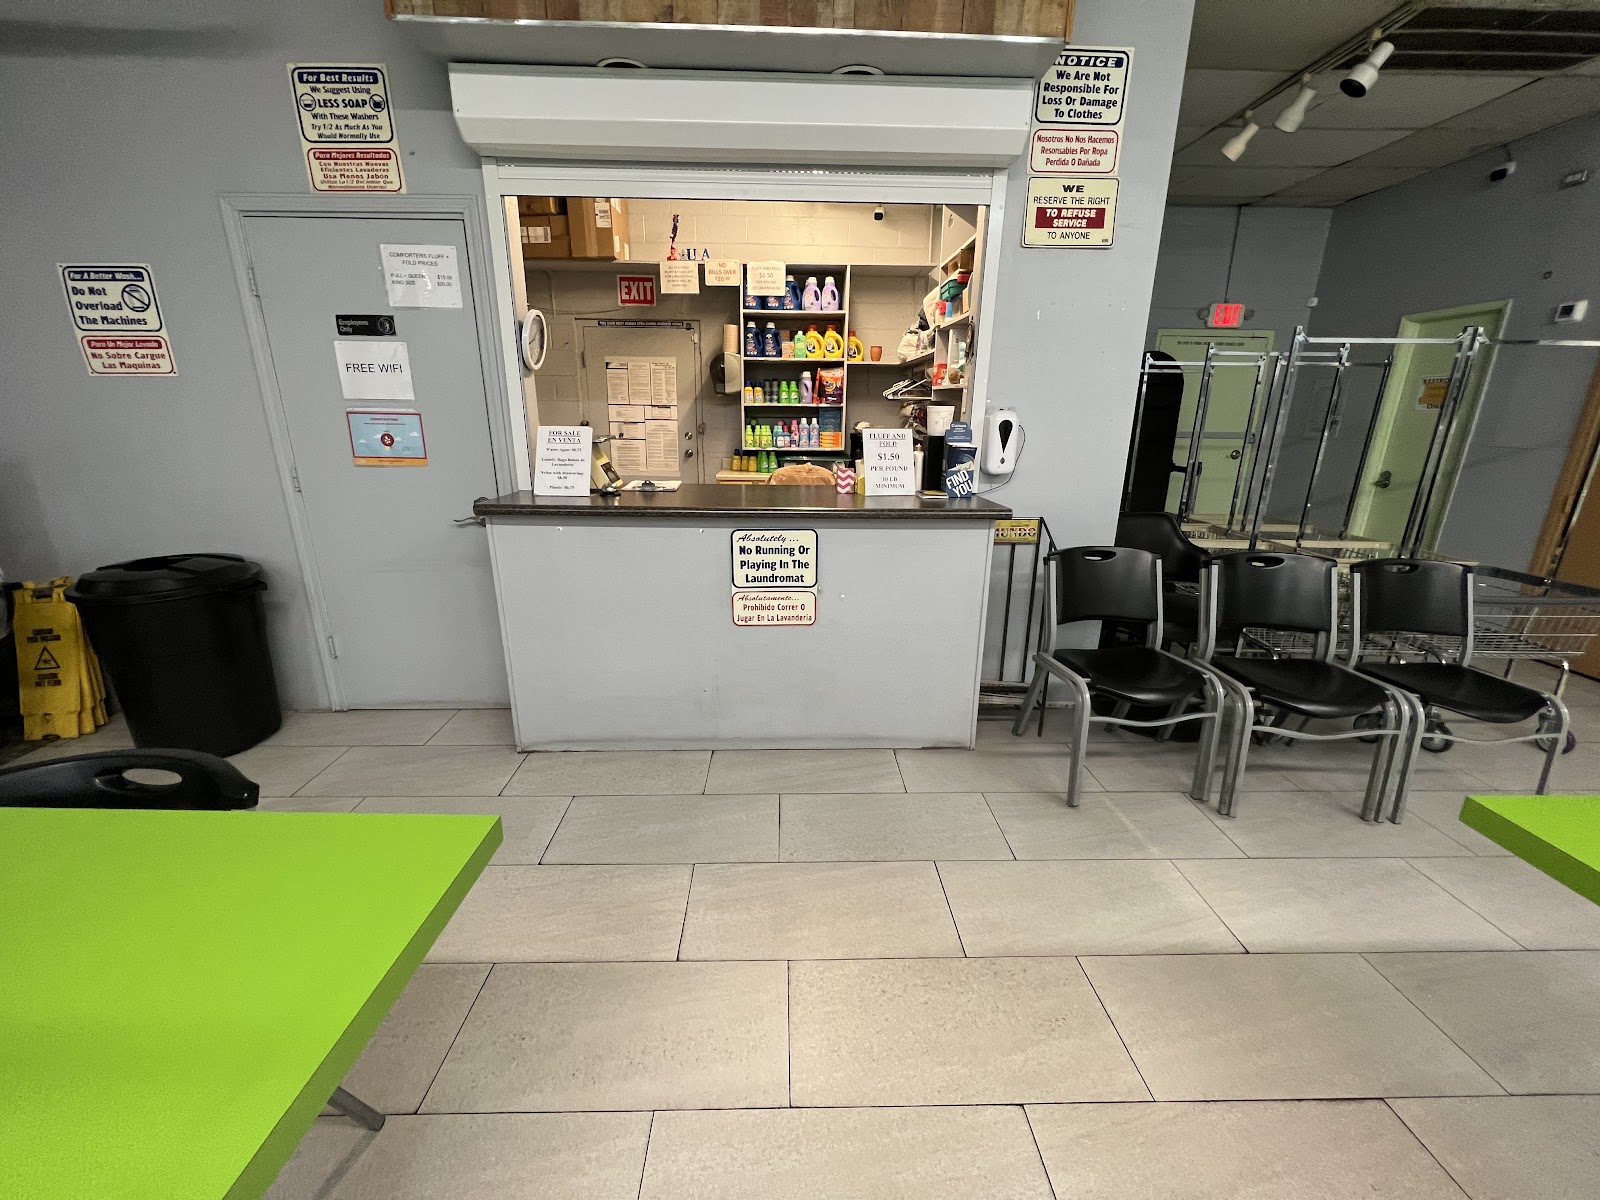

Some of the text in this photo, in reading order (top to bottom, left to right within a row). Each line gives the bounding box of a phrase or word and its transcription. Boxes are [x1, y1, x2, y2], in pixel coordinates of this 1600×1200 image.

[1055, 56, 1117, 67] NOTICE
[303, 74, 374, 82] For Best Results
[1056, 70, 1111, 81] We Are Not
[324, 86, 350, 94] Suggest
[1044, 83, 1119, 94] Responsible For
[318, 99, 367, 108] LESS SOAP
[1042, 96, 1117, 109] Loss Or Damage
[1054, 109, 1103, 119] To Clothes
[1037, 135, 1063, 143] Nosotros
[1065, 135, 1073, 143] No
[1075, 135, 1086, 143] Nos
[1080, 147, 1090, 155] Por
[1092, 148, 1107, 156] Ropa
[1046, 158, 1069, 166] Perdida
[1033, 196, 1067, 204] RESERVE
[1046, 209, 1096, 217] TO REFUSE
[1053, 219, 1087, 227] SERVICE
[71, 286, 107, 296] Do Not
[621, 281, 653, 300] EXIT
[76, 302, 123, 311] Overload
[1213, 304, 1242, 326] EXIT
[79, 316, 147, 325] The Machines
[135, 352, 165, 360] Cargue
[120, 362, 160, 370] Maquinas
[346, 363, 402, 373] FREE WIFI
[946, 470, 969, 489] FIND
[952, 480, 972, 497] YOU
[995, 528, 1036, 537] UNDO
[737, 534, 786, 543] Absolutely
[739, 545, 810, 556] No Running Or
[740, 560, 810, 571] Playing In The
[746, 574, 804, 582] Laundromat
[737, 615, 754, 623] Jugar
